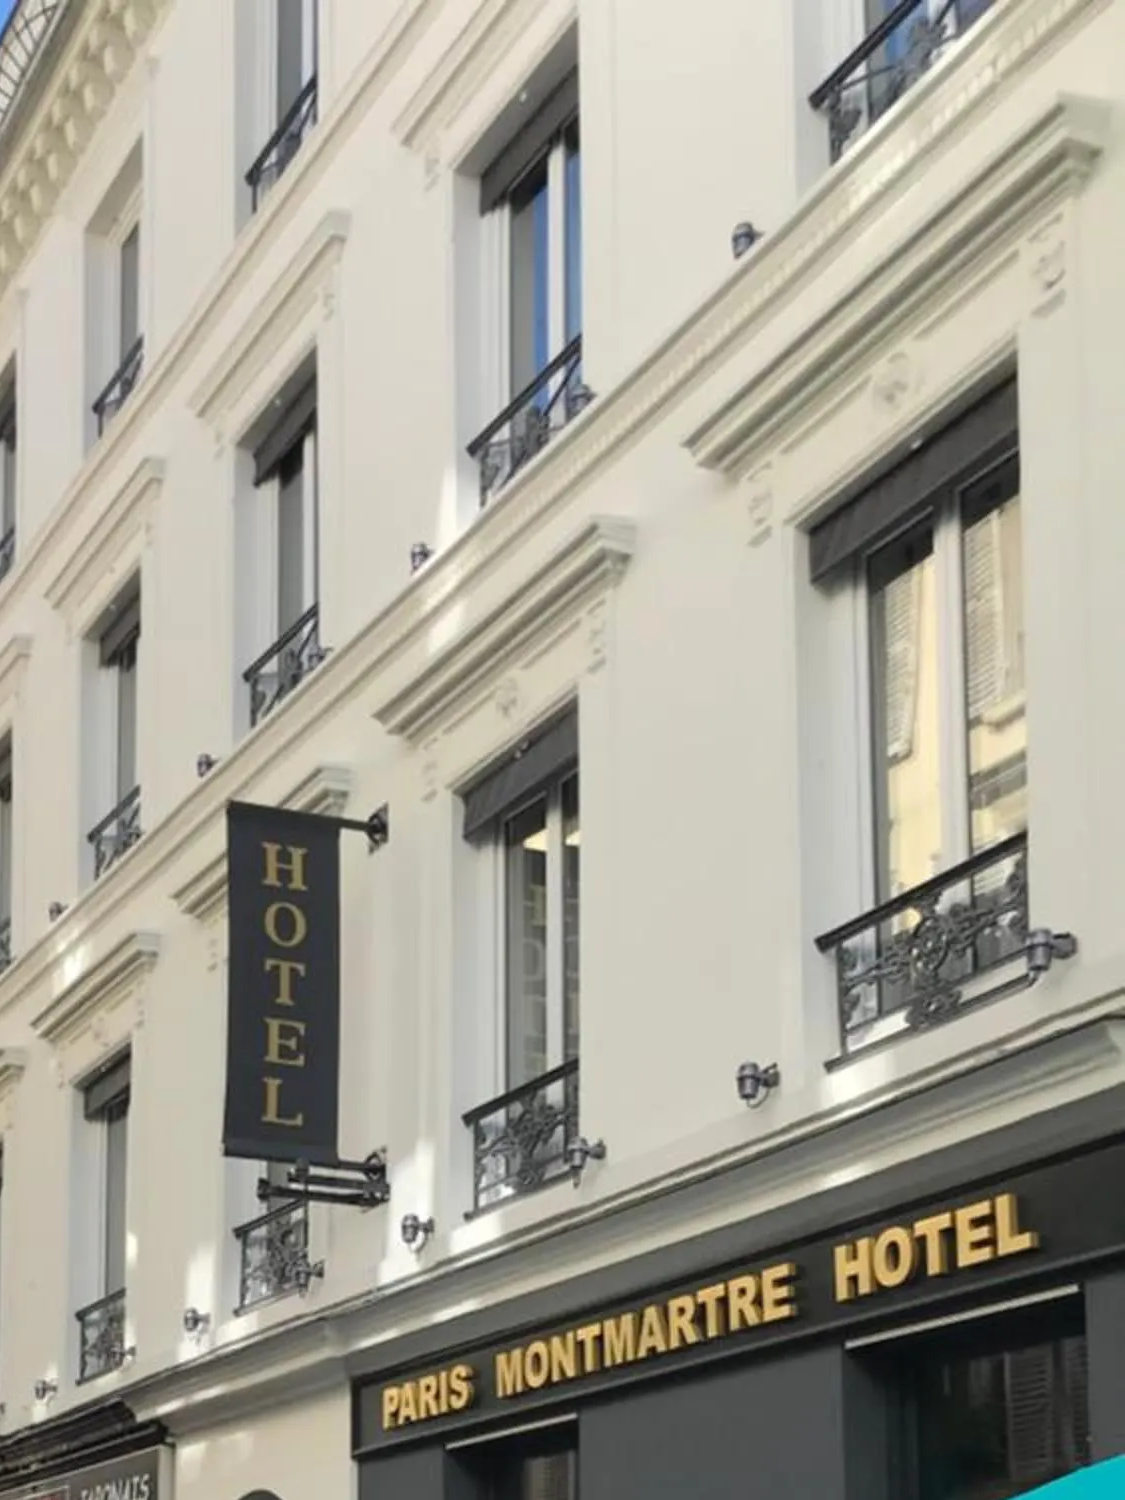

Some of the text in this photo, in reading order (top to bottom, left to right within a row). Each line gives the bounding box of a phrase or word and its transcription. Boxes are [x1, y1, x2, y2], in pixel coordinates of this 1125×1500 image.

[261, 841, 309, 1126] HOTEL
[381, 1192, 1039, 1430] PARIS MONTMARTRE HOTEL
